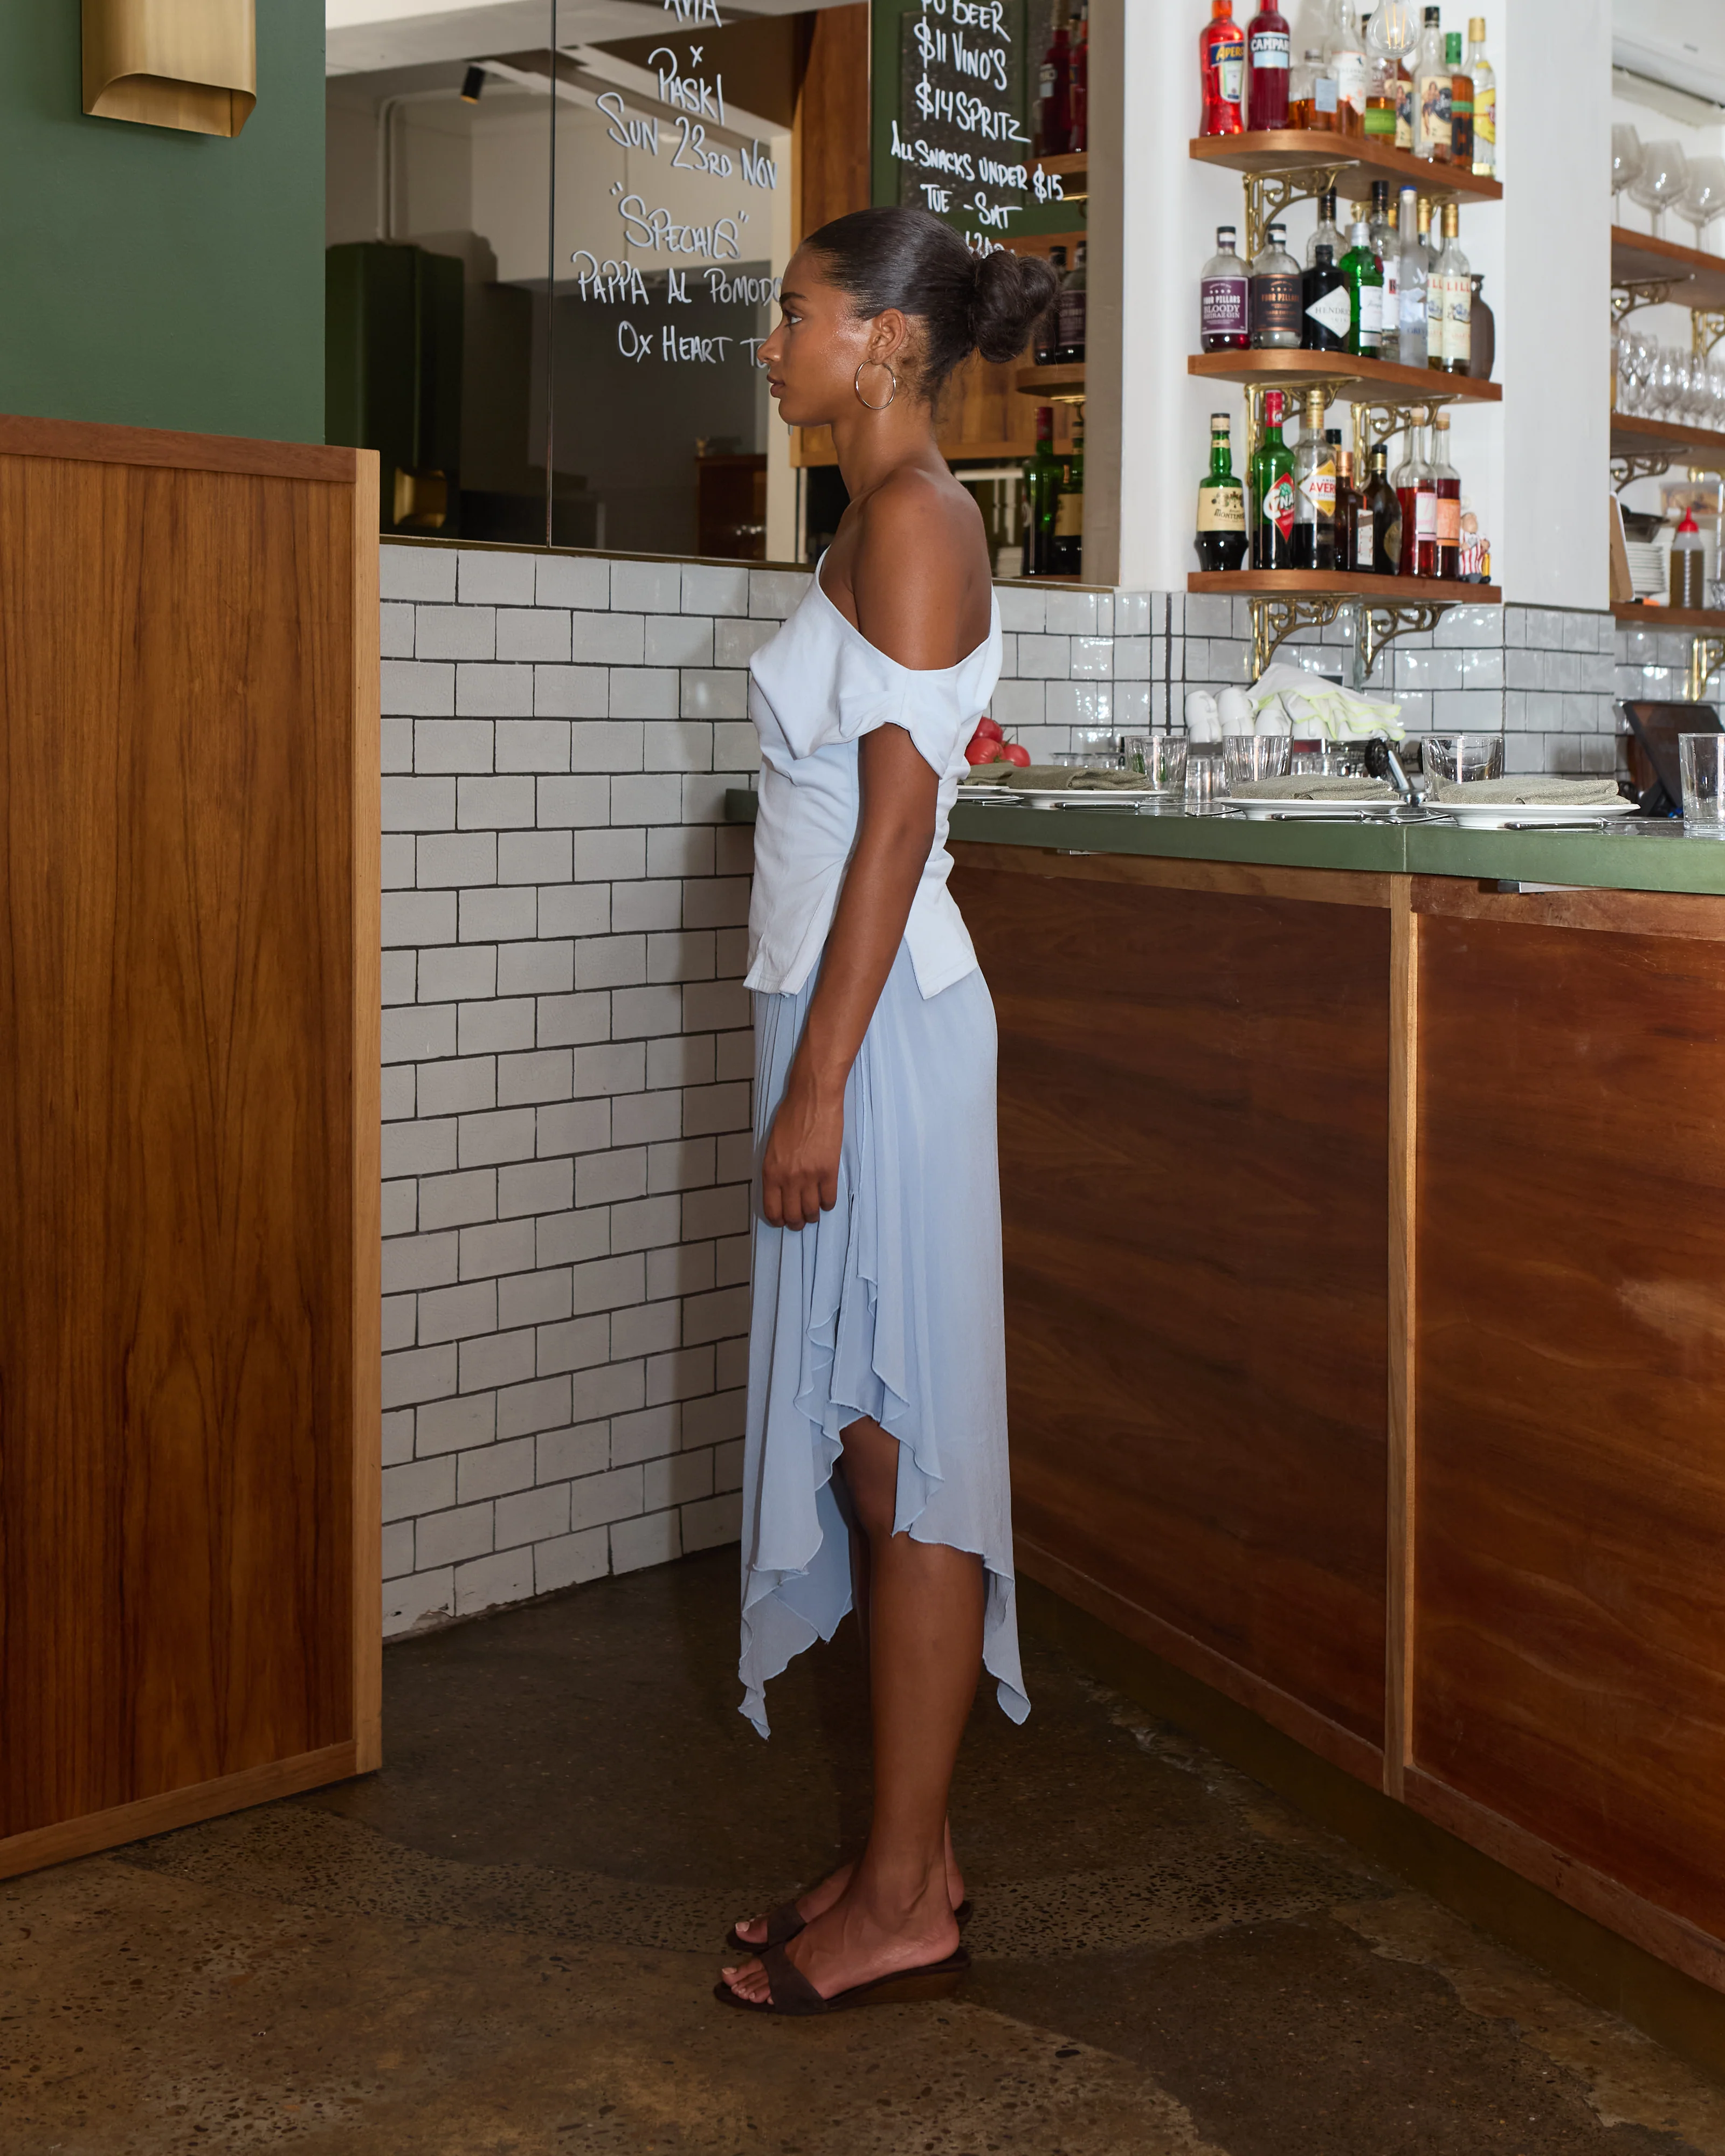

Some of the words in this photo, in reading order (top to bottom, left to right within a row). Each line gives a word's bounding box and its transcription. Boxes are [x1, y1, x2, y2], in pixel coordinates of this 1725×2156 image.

[952, 0, 1012, 43] BEER
[952, 31, 1008, 91] VINO'S
[915, 73, 954, 121] $14
[956, 91, 1032, 143] SPRITZ
[596, 92, 658, 156] SUN
[671, 116, 733, 178] 23RD
[741, 139, 778, 190] NOV
[891, 120, 915, 161] ALL
[915, 139, 975, 182] SNACKS
[978, 157, 1028, 190] UNDER
[1033, 163, 1064, 204] $15
[920, 183, 953, 213] TUE
[571, 250, 650, 305] PAPPA
[668, 267, 692, 304] AL
[1215, 295, 1240, 304] PILLARS
[1204, 304, 1240, 313] BLOODY
[663, 325, 734, 364] HEART
